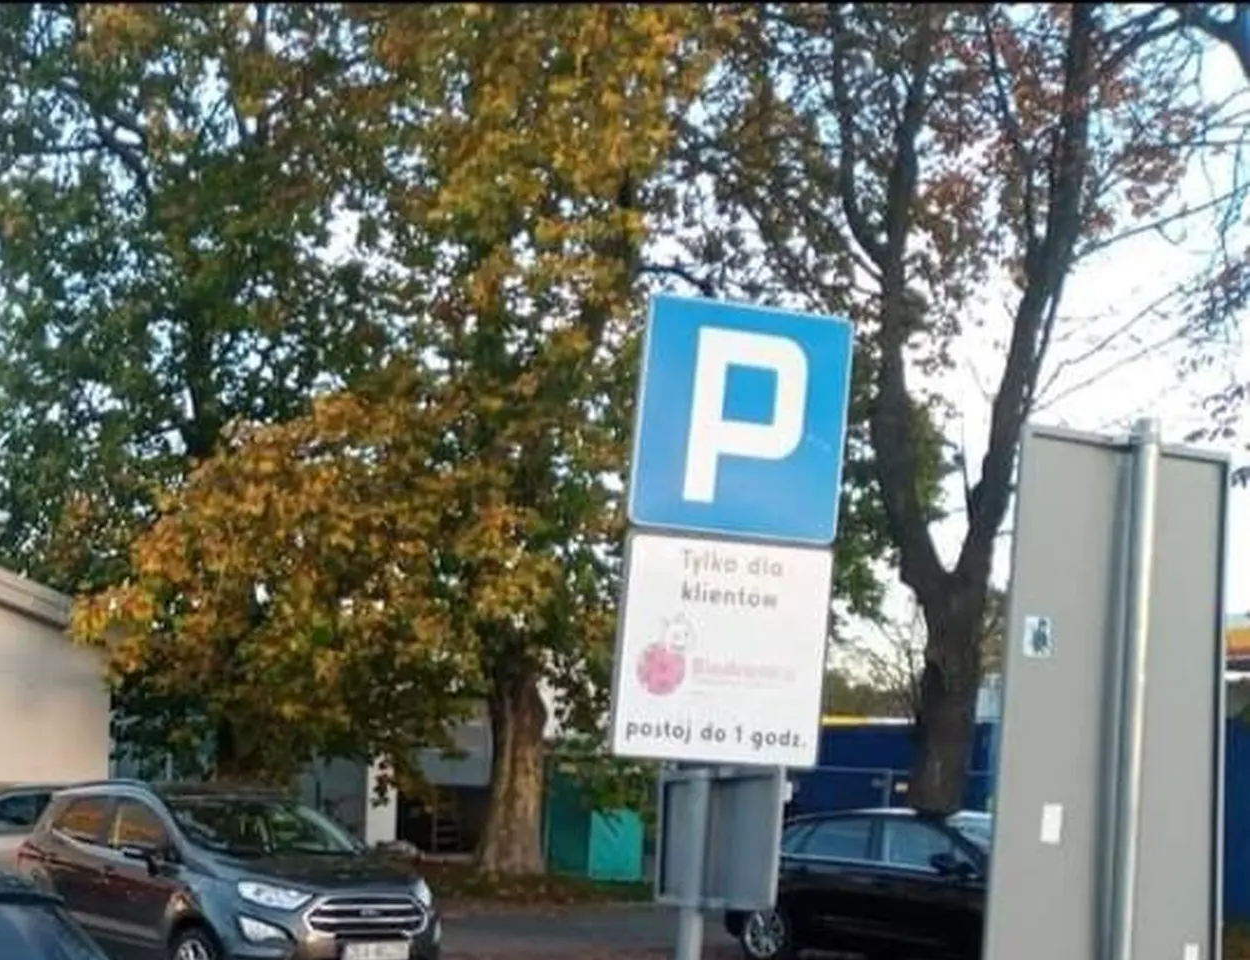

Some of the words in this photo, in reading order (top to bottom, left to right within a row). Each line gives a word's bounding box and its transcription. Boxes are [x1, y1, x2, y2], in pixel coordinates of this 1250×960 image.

[684, 326, 807, 503] P
[681, 549, 739, 577] Tylko
[748, 555, 783, 577] dla
[625, 721, 691, 745] postoj
[700, 724, 726, 742] do
[735, 725, 743, 743] 1
[750, 729, 807, 751] godz.
